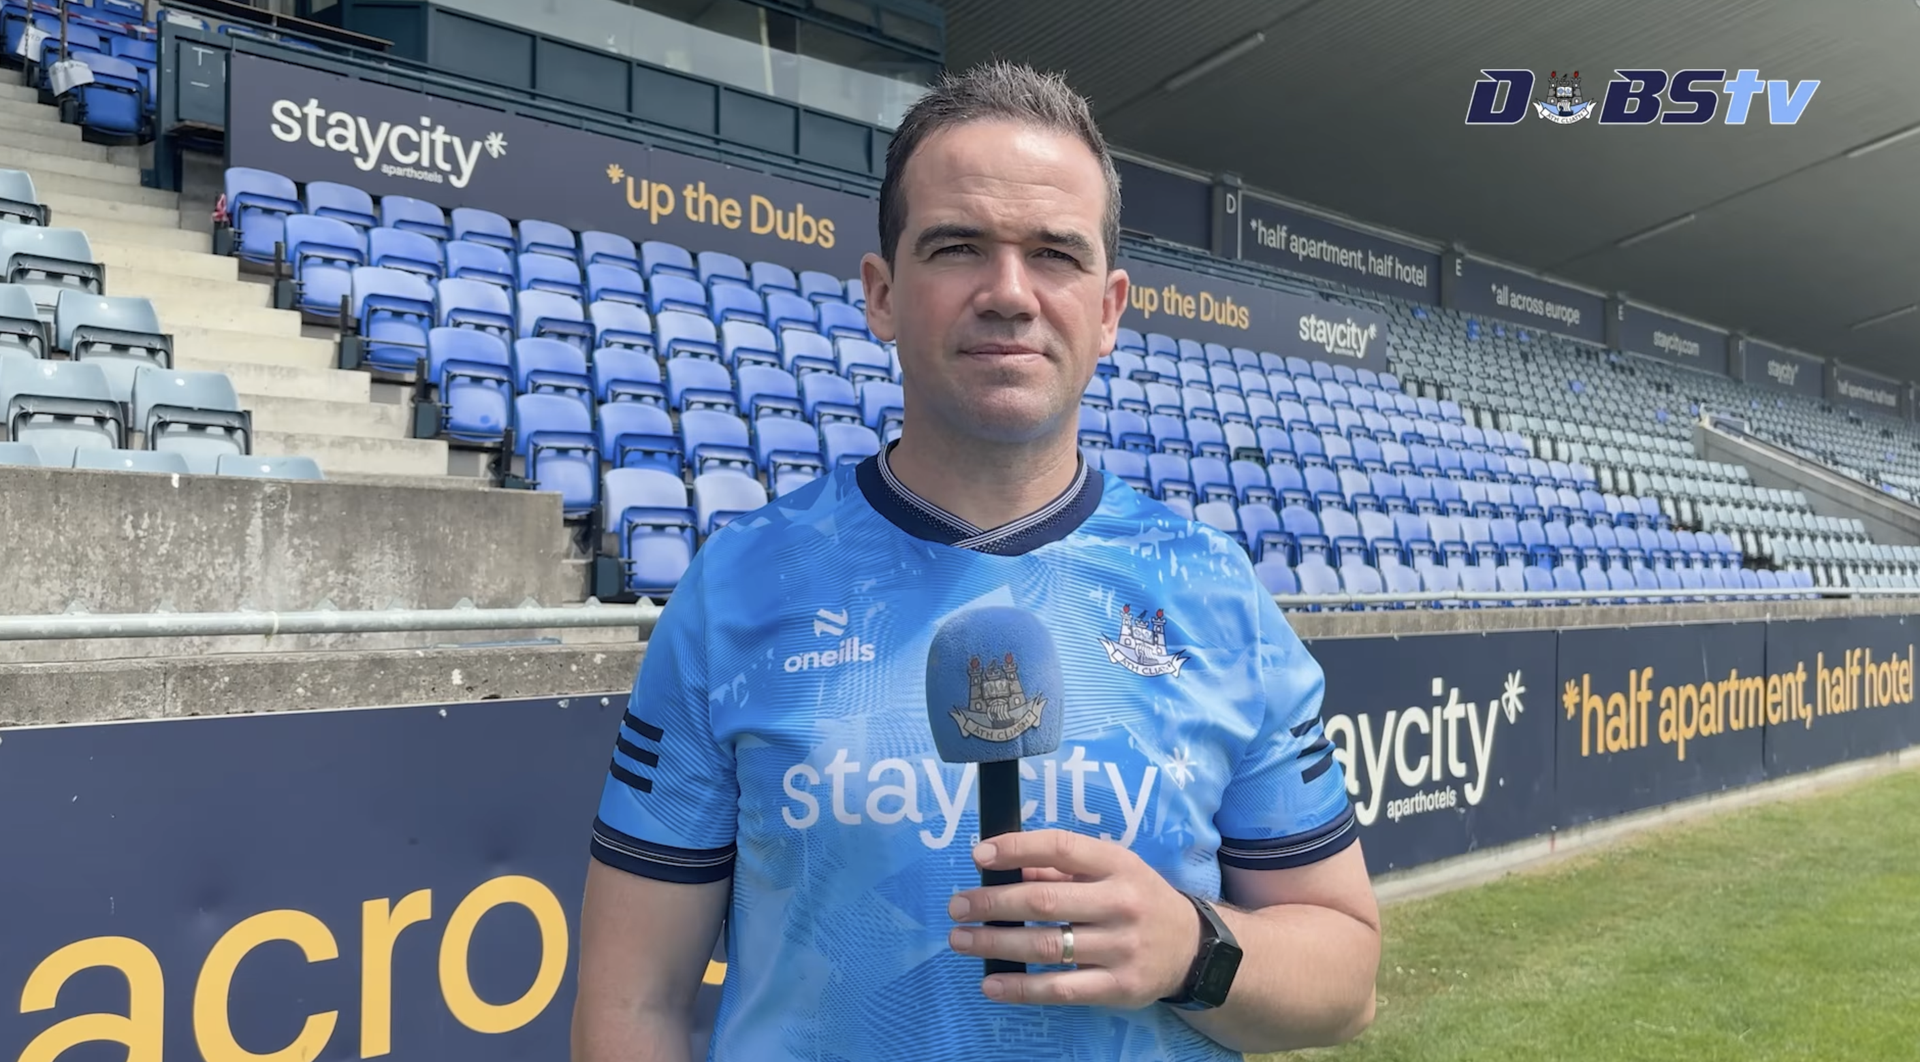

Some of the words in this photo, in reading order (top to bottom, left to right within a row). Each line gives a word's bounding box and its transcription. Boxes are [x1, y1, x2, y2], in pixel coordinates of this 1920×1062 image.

[381, 163, 443, 184] aparthotels
[682, 181, 742, 230] the
[750, 194, 835, 249] Dubs
[1226, 193, 1237, 214] D
[1289, 234, 1367, 275] apartment,
[1368, 249, 1394, 279] half
[1395, 261, 1428, 288] hotel
[1130, 285, 1159, 320] up
[1162, 283, 1197, 320] the
[1200, 291, 1250, 330] Dubs
[1510, 296, 1544, 317] across
[1545, 301, 1581, 327] europe
[784, 637, 876, 673] oneills
[1142, 664, 1169, 675] CLIA
[1658, 660, 1812, 762] apartment,
[1817, 647, 1862, 716] half
[1864, 643, 1914, 709] hotel
[1323, 670, 1527, 826] aycity
[1386, 786, 1458, 823] aparthotels
[15, 874, 726, 1062] acro
